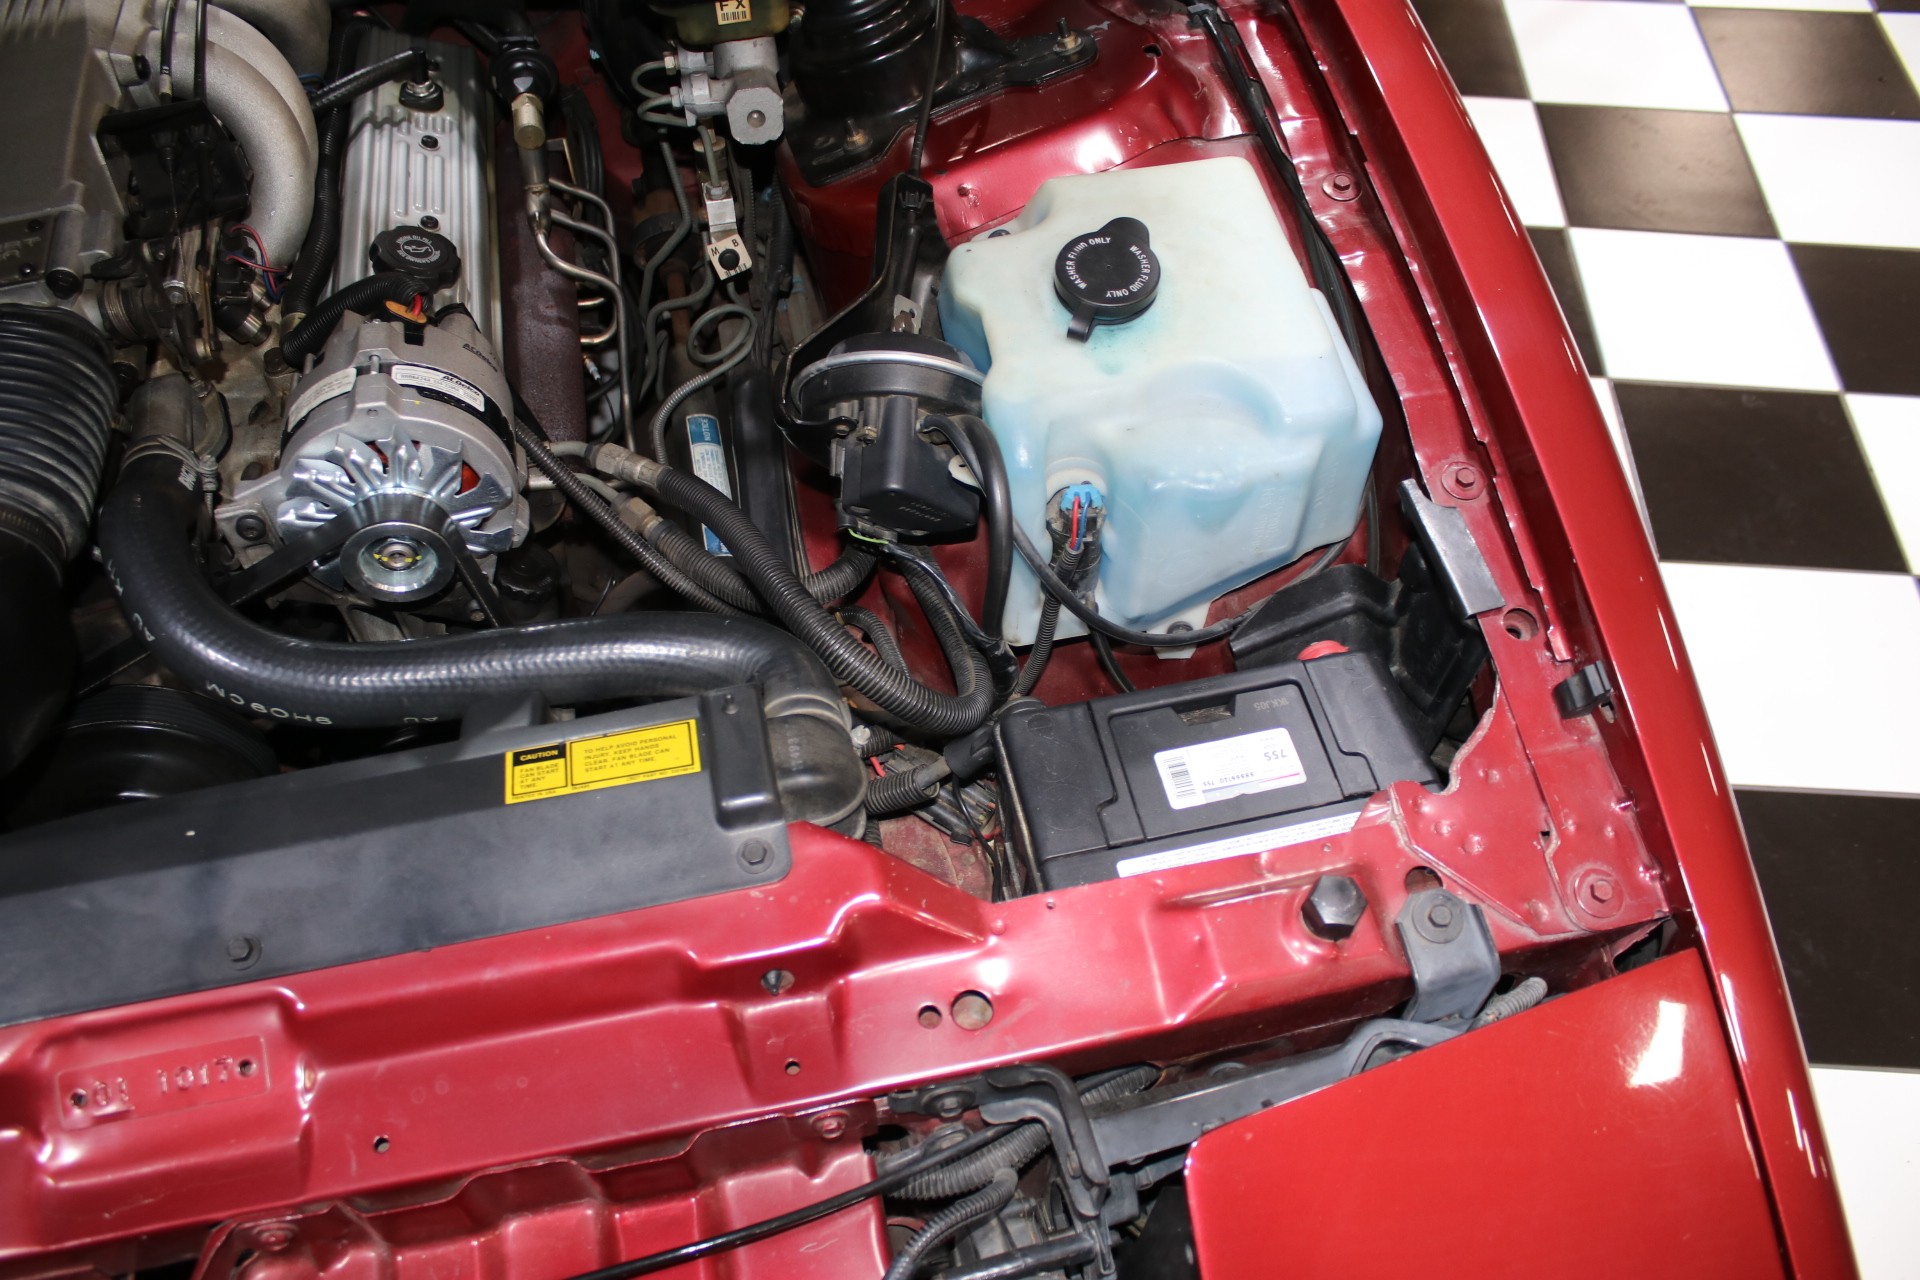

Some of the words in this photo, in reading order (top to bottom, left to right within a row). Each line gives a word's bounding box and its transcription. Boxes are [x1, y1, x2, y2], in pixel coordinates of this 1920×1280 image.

[1065, 260, 1087, 290] WASHER
[1088, 237, 1111, 245] ONLY
[1129, 245, 1151, 273] WASHER
[1129, 274, 1149, 292] FLUID
[1105, 288, 1129, 298] ONLY
[441, 375, 480, 396] ACDelco
[701, 418, 711, 441] NOTICE
[616, 741, 638, 749] AVOID
[640, 735, 676, 744] PERSONAL
[634, 743, 659, 751] HANDS
[520, 750, 559, 761] CAUTION
[629, 751, 652, 759] BLADE
[536, 763, 559, 771] BLADE
[537, 768, 559, 776] START
[585, 764, 607, 773] START
